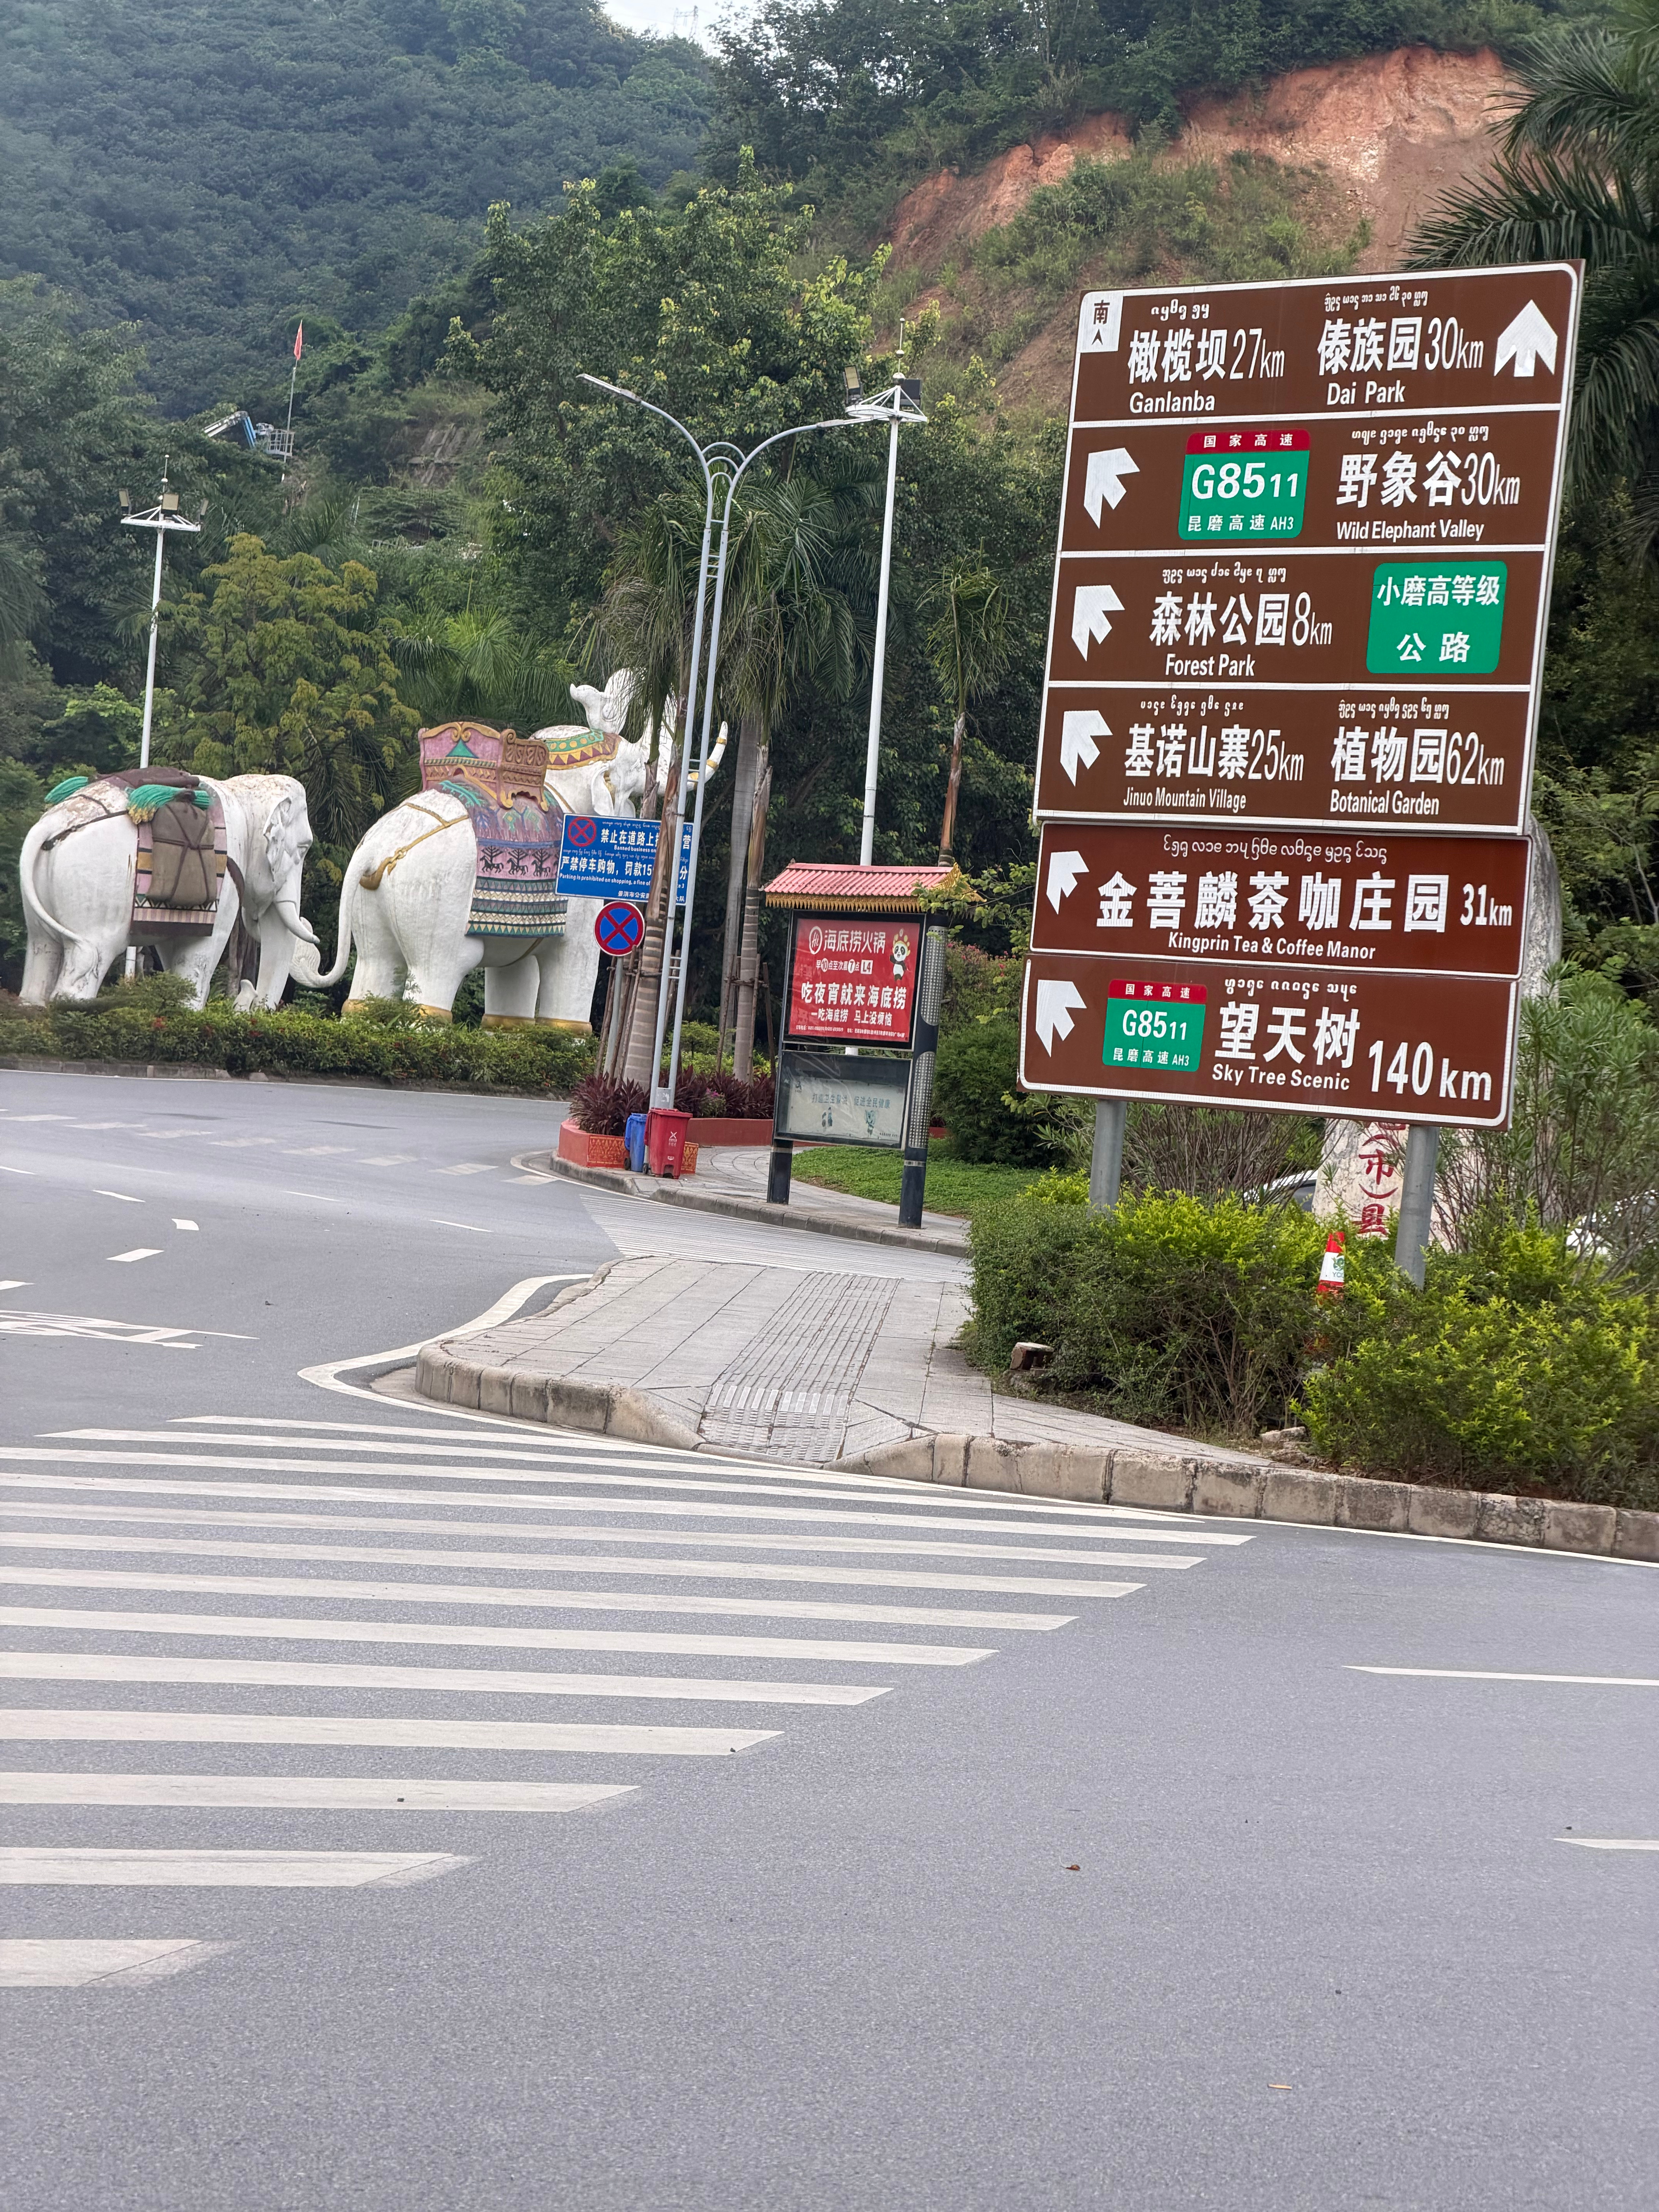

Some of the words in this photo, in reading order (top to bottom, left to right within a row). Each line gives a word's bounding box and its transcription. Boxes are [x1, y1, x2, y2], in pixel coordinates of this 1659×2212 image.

[1094, 300, 1110, 325] 南
[1130, 390, 1215, 413] Ganlanba
[1327, 382, 1356, 405] Dai
[1365, 380, 1406, 404] Park
[1203, 434, 1293, 448] 国家高速
[1192, 462, 1298, 500] G8511
[1188, 514, 1265, 532] 昆磨高速
[1270, 517, 1294, 530] AH3
[1337, 521, 1369, 539] Wild
[1372, 521, 1436, 543] Elephant
[1439, 519, 1484, 541] Valley
[1377, 575, 1500, 606] 小磨高等级
[1396, 632, 1471, 663] 公路
[1165, 653, 1215, 676] Forest
[1218, 654, 1255, 676] Park
[1123, 787, 1153, 807] Jinuo
[1155, 787, 1206, 808] Mountain
[1209, 788, 1247, 813] Village
[1330, 789, 1389, 813] Botanical
[1393, 790, 1440, 815] Garden
[683, 835, 691, 849] 营
[625, 861, 654, 876] 罚款15
[679, 866, 687, 880] 分
[1096, 871, 1449, 933] 金菩麟茶咖庄园
[1460, 883, 1512, 926] 31km
[823, 929, 886, 954] 海底捞火锅
[1168, 932, 1229, 953] Kingprin
[1233, 936, 1258, 953] Tea
[1261, 937, 1273, 954] &
[1277, 938, 1323, 957] Coffee
[1327, 941, 1376, 959] Manor
[801, 981, 907, 1010] 吃夜宵就来海底捞
[1125, 983, 1191, 999] 国家高速
[811, 1008, 848, 1022] 一吃海底捞
[854, 1010, 893, 1026] 马上没烦恼
[1123, 1010, 1187, 1040] G8511
[1214, 1001, 1360, 1069] 望天树
[1113, 1047, 1168, 1065] 昆磨高速
[1172, 1054, 1189, 1066] AH3
[1212, 1063, 1244, 1086] Sky
[1248, 1066, 1286, 1085] Tree
[1290, 1069, 1350, 1090] Scenic
